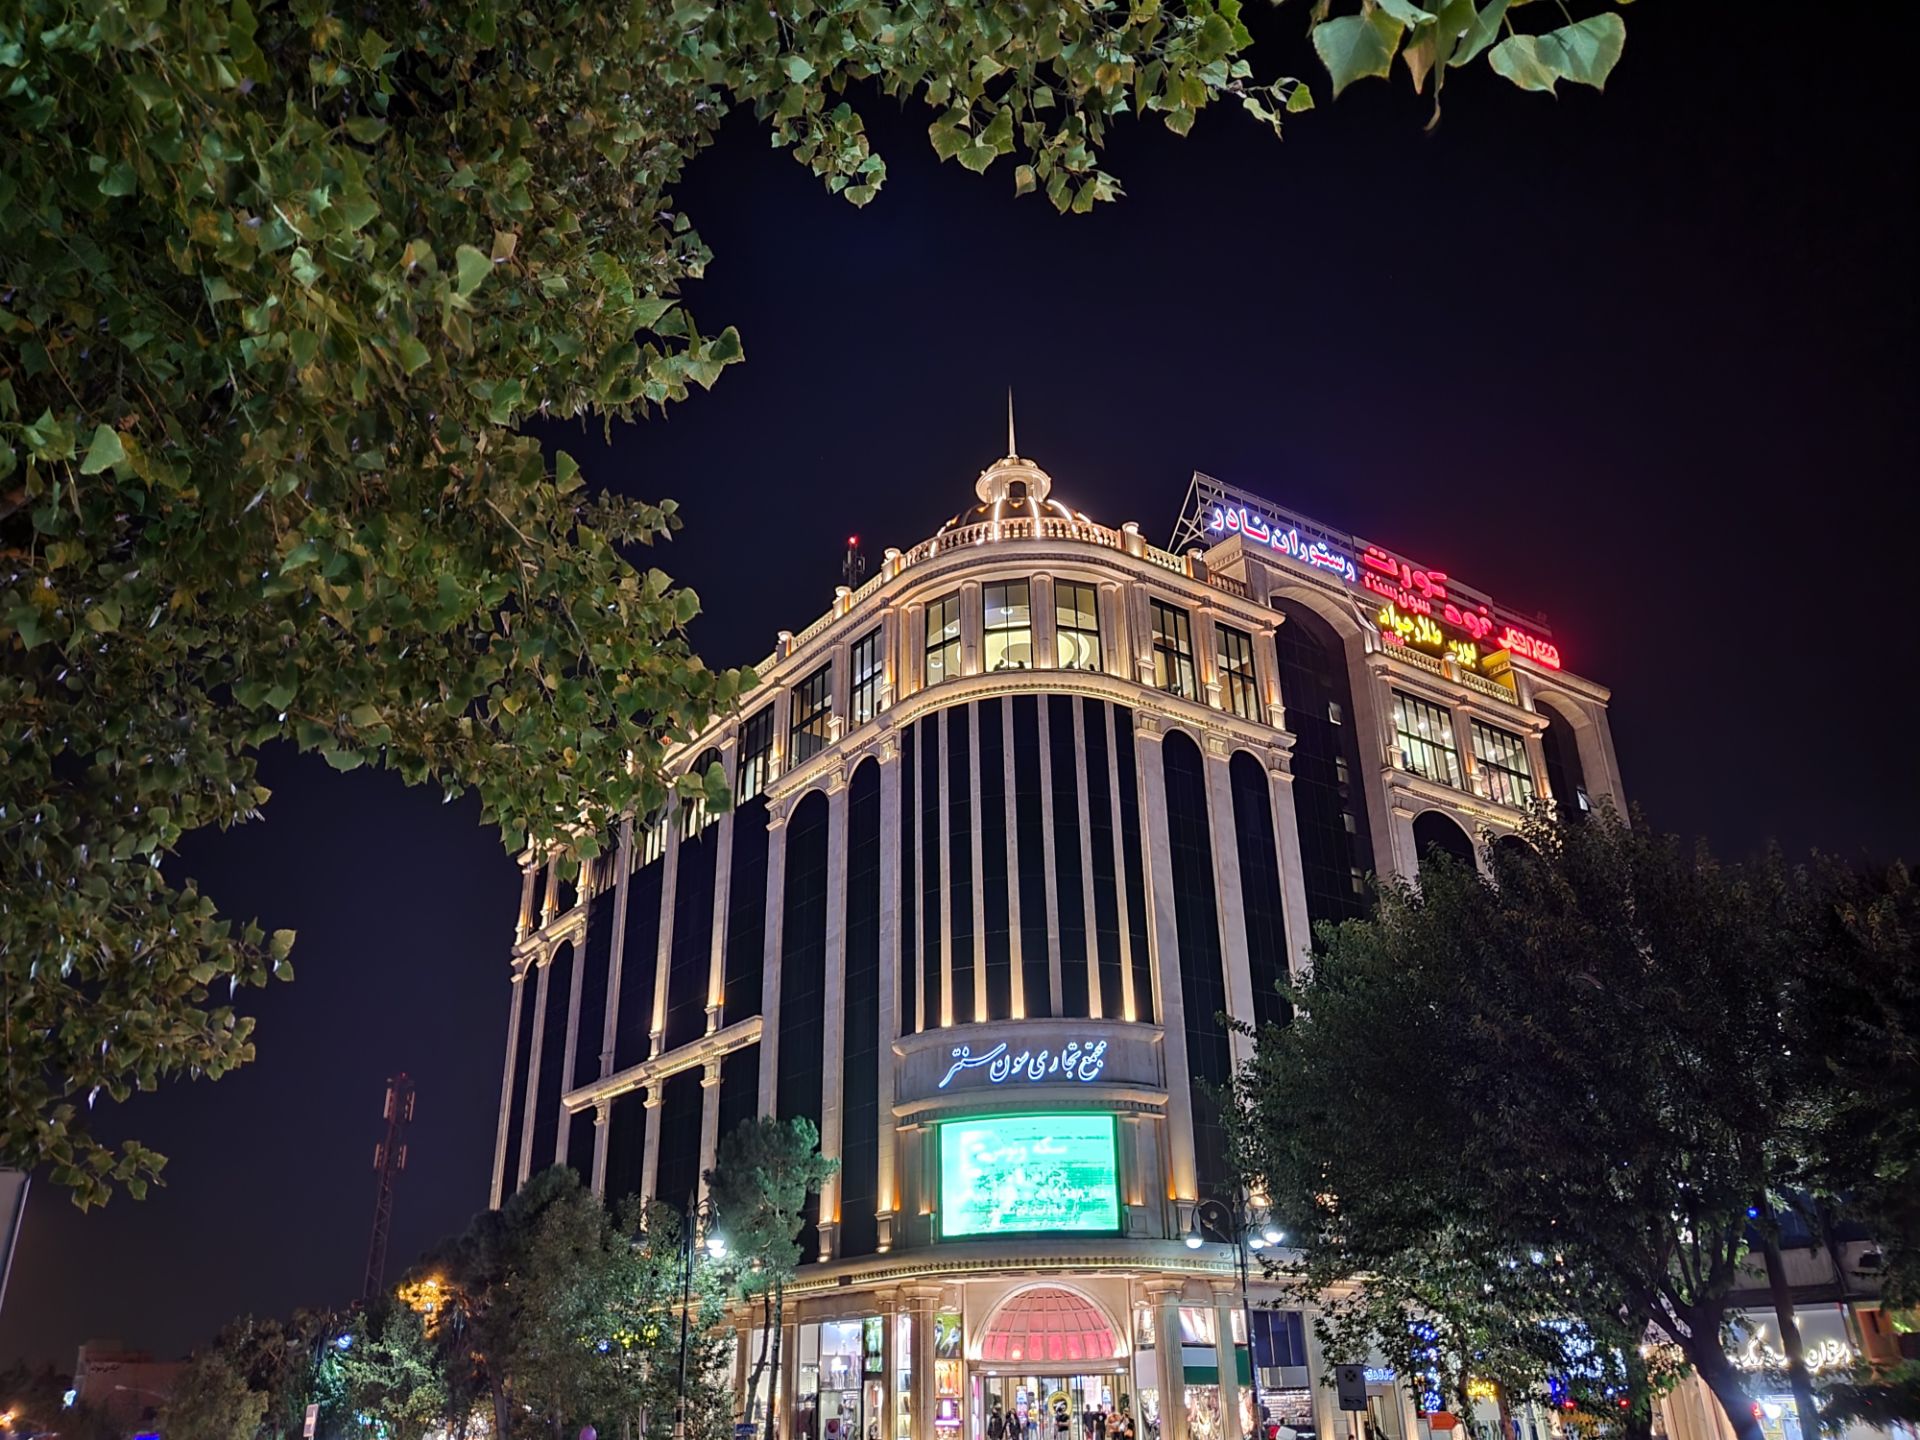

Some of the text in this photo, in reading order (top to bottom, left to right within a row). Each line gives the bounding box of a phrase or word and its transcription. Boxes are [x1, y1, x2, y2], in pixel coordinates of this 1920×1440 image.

[1210, 507, 1356, 582] رستوران نادر
[1364, 547, 1493, 639] فود کورت
[1398, 586, 1431, 614] سون
[939, 1040, 1107, 1088] مجتمع تجاری سون سنتر
